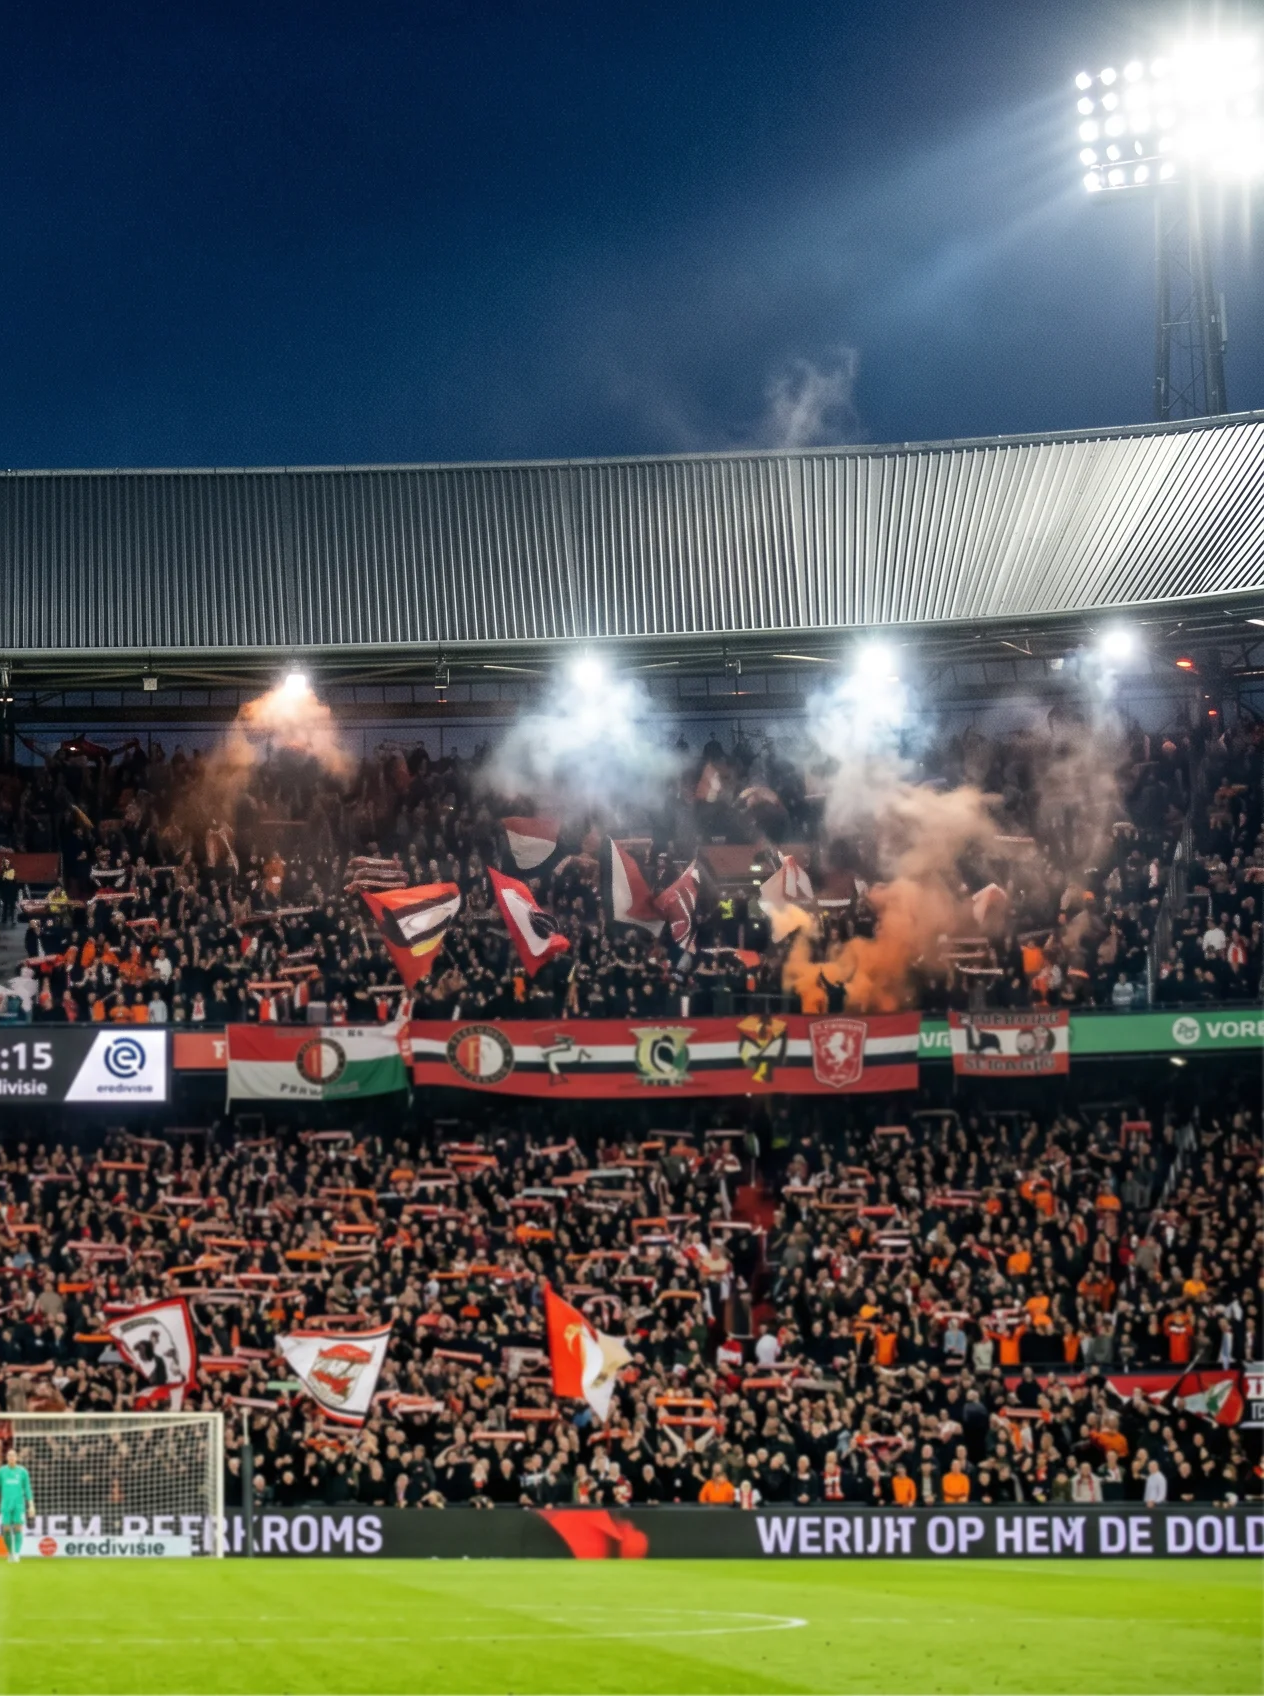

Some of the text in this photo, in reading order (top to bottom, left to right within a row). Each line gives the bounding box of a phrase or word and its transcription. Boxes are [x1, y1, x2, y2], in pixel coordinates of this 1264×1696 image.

[64, 1538, 165, 1556] eredivisie
[926, 1516, 985, 1554] OP
[996, 1516, 1086, 1554] HEM
[1099, 1516, 1153, 1554] DE
